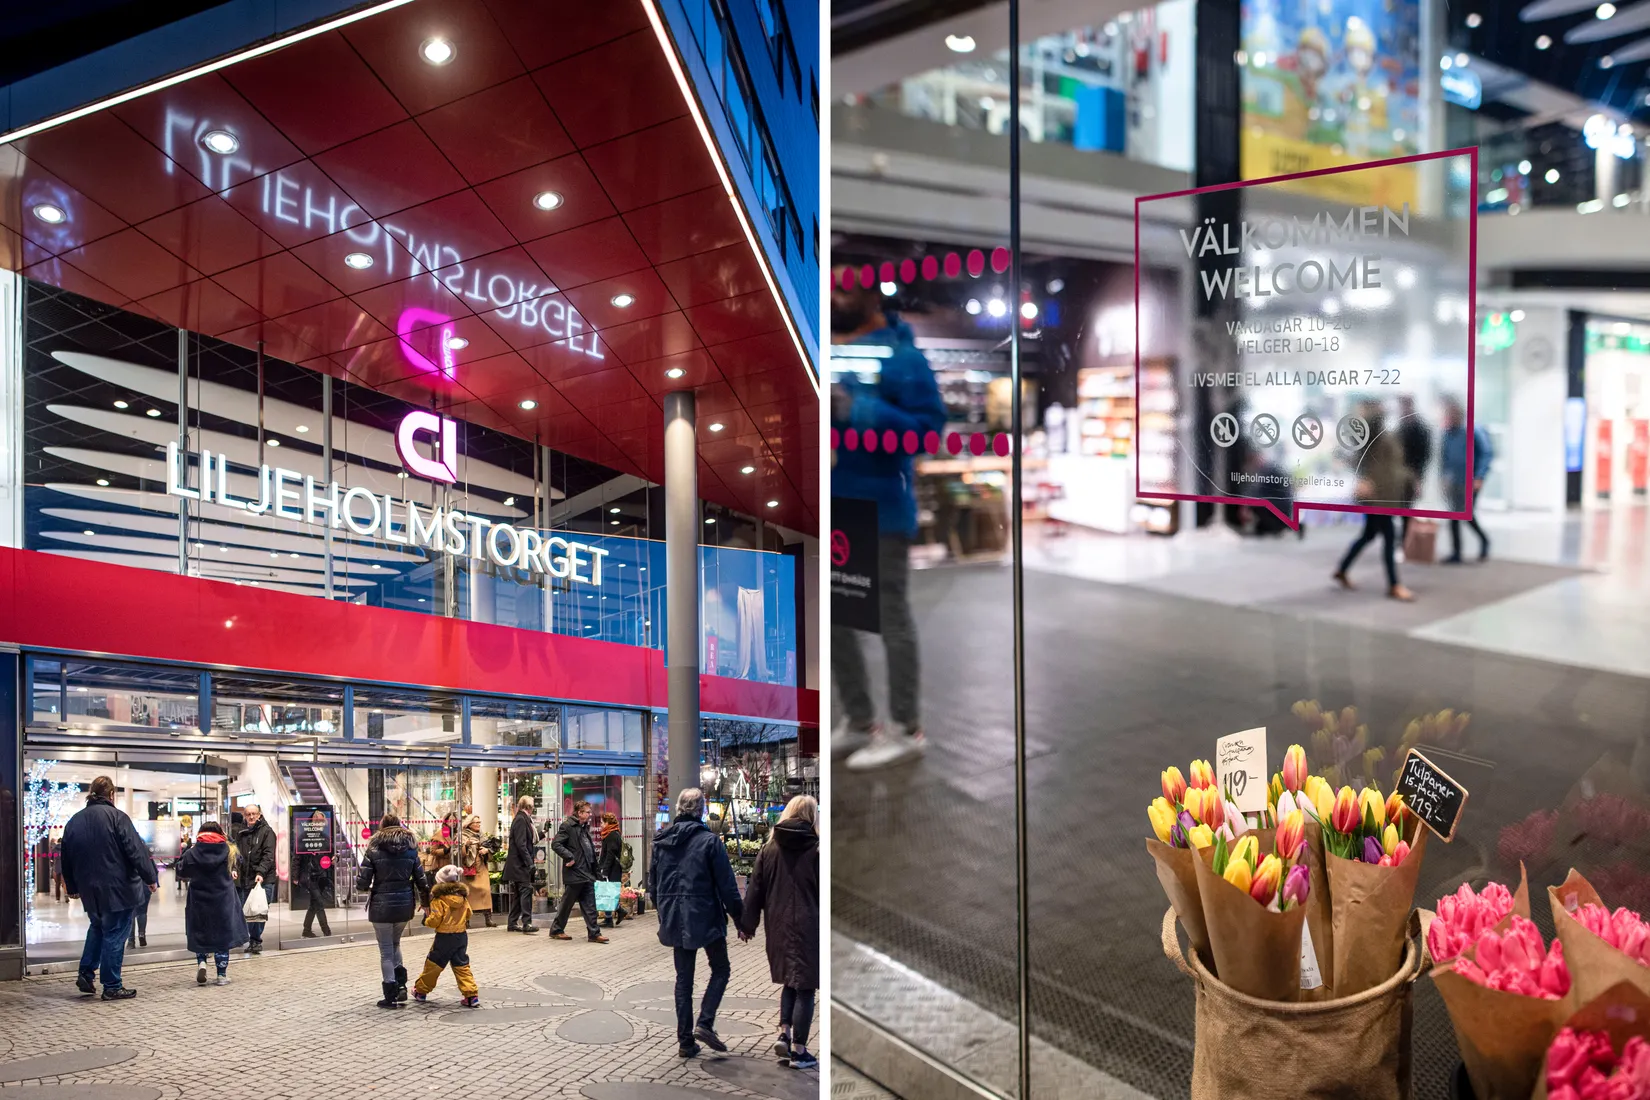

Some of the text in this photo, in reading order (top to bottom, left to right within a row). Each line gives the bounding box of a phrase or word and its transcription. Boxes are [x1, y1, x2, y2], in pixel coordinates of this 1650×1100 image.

[1179, 202, 1410, 259] VÄLKOMMEN
[1200, 254, 1382, 301] WELCOME
[1226, 317, 1303, 336] VARDAGAR
[1236, 336, 1341, 355] HELGER 10-18
[1186, 369, 1402, 388] LIVSMEDEL ALLA DAGAR 7-22
[166, 440, 609, 587] LILJEHOLMSTORGET
